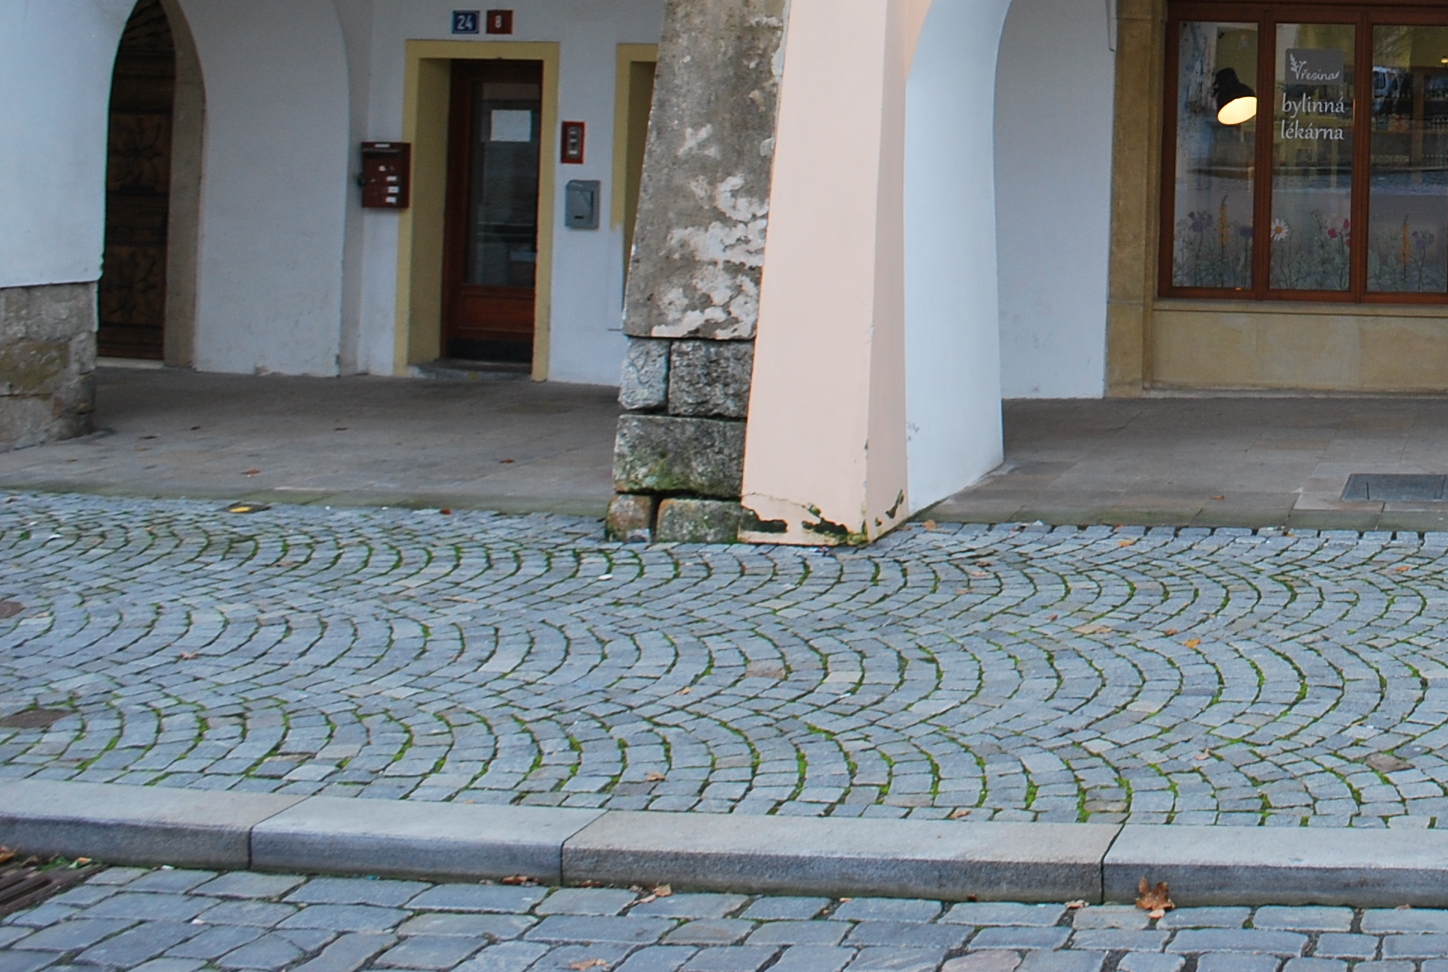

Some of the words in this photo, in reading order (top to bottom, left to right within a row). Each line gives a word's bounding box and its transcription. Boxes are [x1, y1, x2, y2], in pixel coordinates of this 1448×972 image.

[457, 15, 474, 30] 24
[1282, 93, 1345, 119] bylinná
[1281, 119, 1344, 140] lékárna
